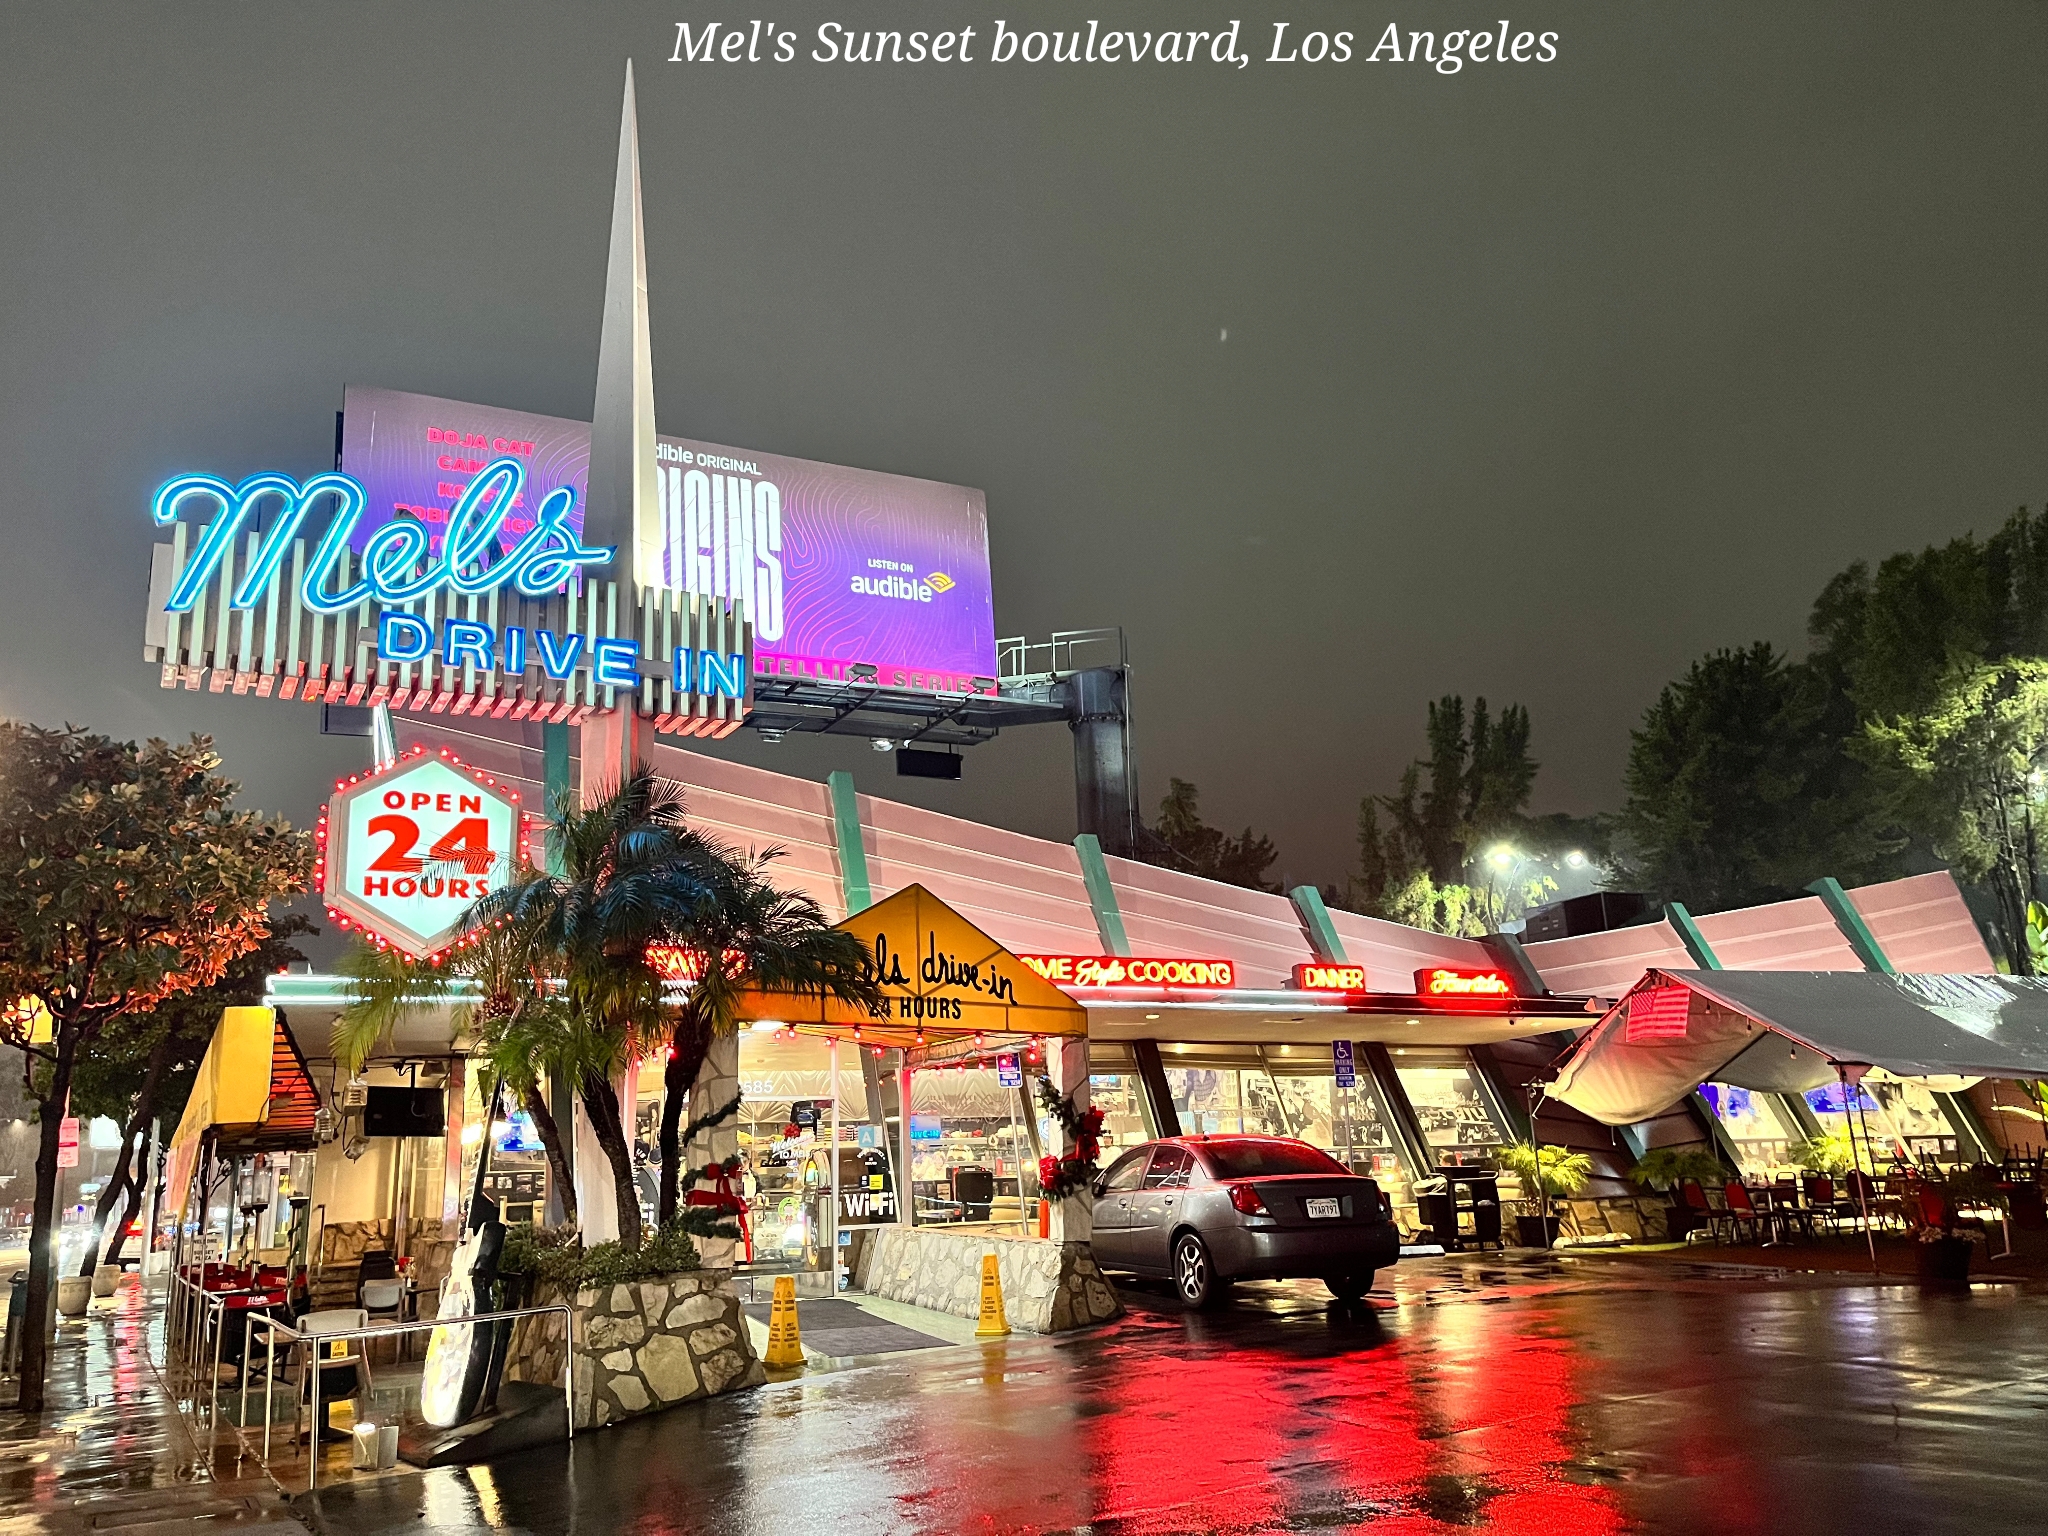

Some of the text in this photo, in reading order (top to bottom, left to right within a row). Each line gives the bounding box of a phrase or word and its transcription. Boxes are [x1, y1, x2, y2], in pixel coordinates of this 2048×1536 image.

[427, 427, 535, 456] DOJA CAT
[656, 443, 762, 476] dible ORIGINAL
[153, 457, 618, 615] Mels
[867, 558, 914, 573] LISTEN ON
[851, 575, 933, 602] audible
[377, 611, 745, 699] DRIVE IN
[893, 671, 986, 695] SERIE
[383, 791, 481, 814] OPEN
[366, 814, 496, 875] 24
[364, 876, 489, 899] HOURS
[921, 930, 1018, 1006] drive-in
[1020, 957, 1231, 988] OME Style COOKING
[1304, 967, 1364, 989] DINNER
[900, 996, 961, 1019] HOURS
[742, 1080, 774, 1094] 585
[861, 1131, 873, 1144] A
